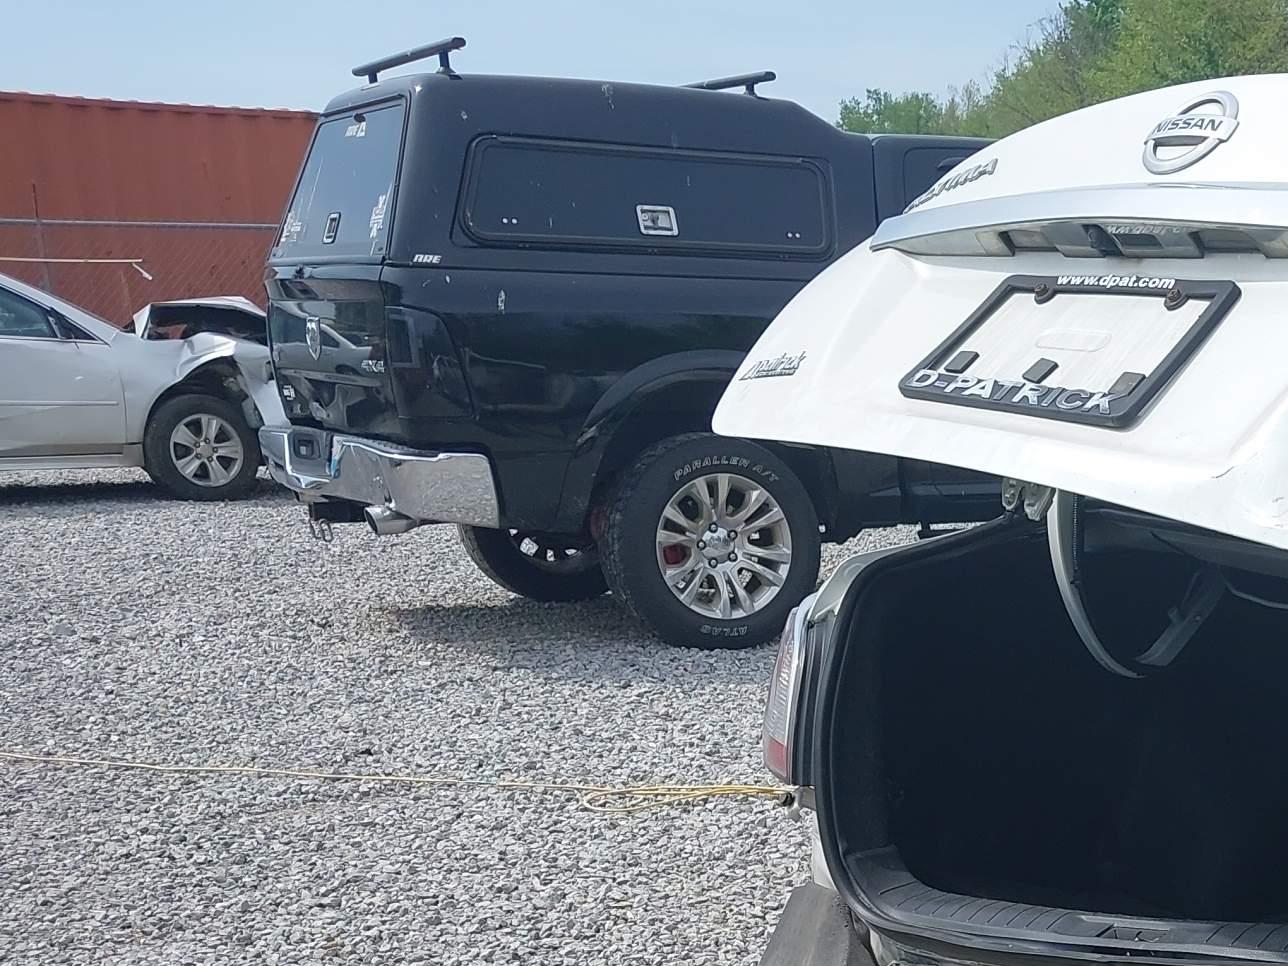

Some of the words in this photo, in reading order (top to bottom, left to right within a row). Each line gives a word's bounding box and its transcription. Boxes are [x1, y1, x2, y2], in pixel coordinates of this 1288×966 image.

[1151, 117, 1223, 135] NISSAN
[1056, 274, 1176, 289] www.dpat.com
[905, 369, 1118, 415] D-PATRICK
